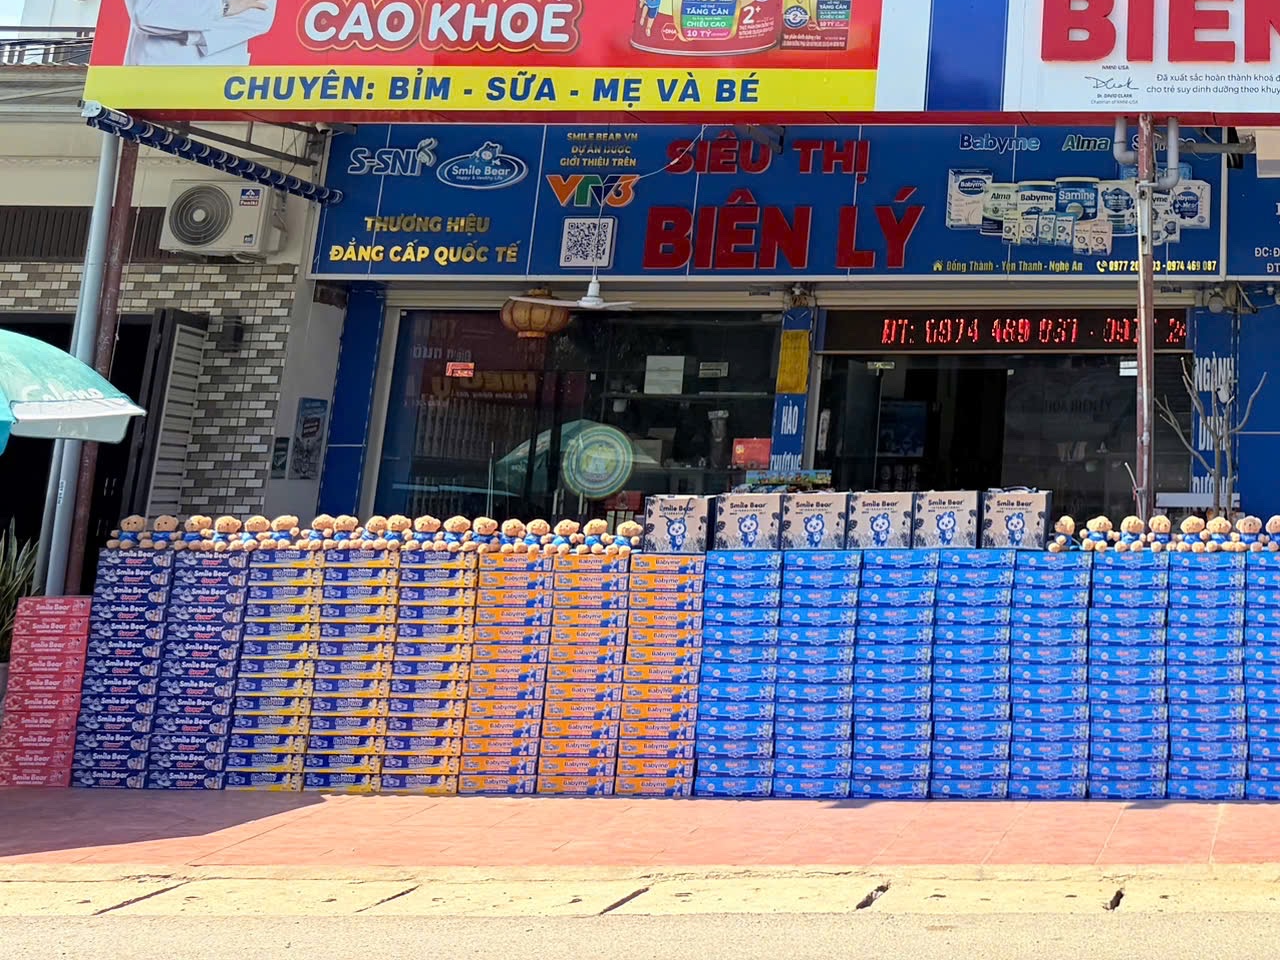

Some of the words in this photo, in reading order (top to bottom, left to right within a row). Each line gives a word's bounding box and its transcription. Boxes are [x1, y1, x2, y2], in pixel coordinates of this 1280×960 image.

[305, 1, 415, 42] CAO
[223, 70, 374, 101] CHUYÊN:
[389, 68, 450, 101] BỈM
[486, 73, 556, 102] SỮA
[592, 78, 642, 109] MẸ
[657, 72, 700, 102] VÀ
[715, 72, 760, 102] BÉ
[665, 131, 772, 175] SIÊU
[793, 140, 870, 184] THỊ
[960, 133, 1040, 155] Babyme
[1062, 134, 1111, 152] Alma
[452, 165, 481, 176] Smile
[484, 166, 511, 177] Bear
[545, 174, 640, 207] VTV3
[365, 212, 442, 233] THƯƠNG
[446, 213, 490, 236] HIỆU
[643, 188, 811, 270] BIÊN
[836, 186, 926, 269] LÝ
[329, 236, 384, 262] ĐẲNG
[389, 238, 430, 262] CẤP
[434, 240, 490, 263] QUỐC
[495, 239, 521, 263] TẾ
